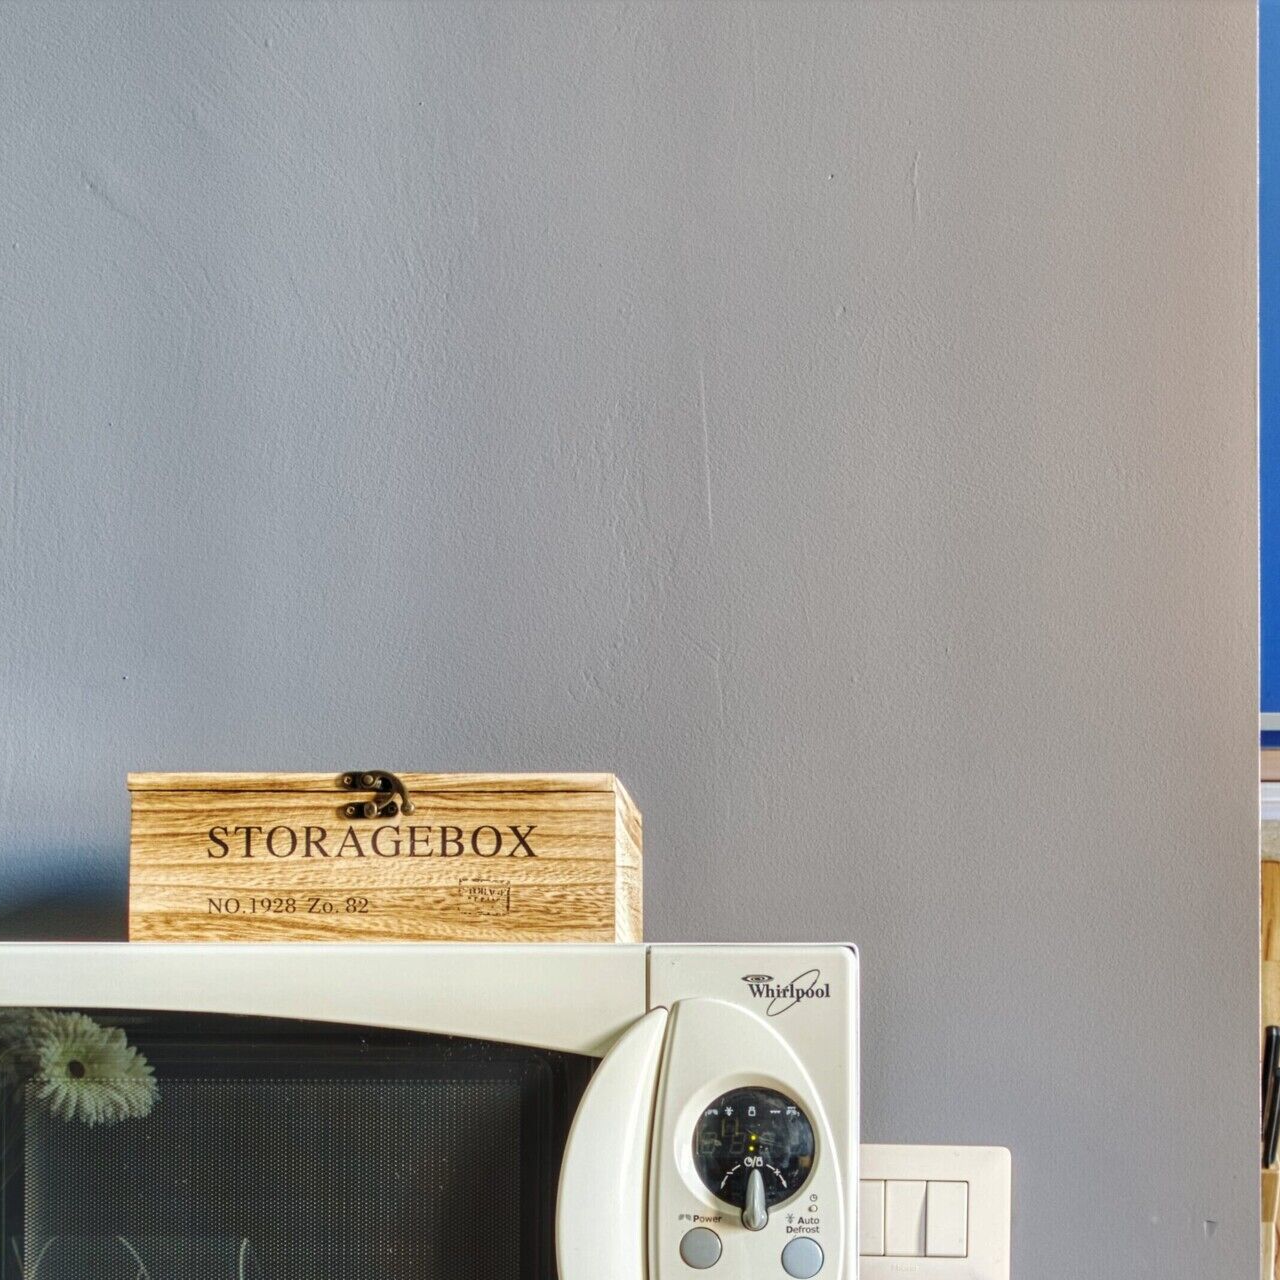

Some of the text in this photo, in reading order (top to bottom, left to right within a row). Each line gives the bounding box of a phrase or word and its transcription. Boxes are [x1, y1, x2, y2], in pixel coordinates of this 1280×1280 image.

[207, 824, 539, 859] STORAGEBOX
[208, 898, 369, 914] NO.1928 Zo. 82
[749, 983, 831, 1002] Whirlpool
[693, 1214, 722, 1223] Power
[797, 1216, 820, 1224] Auto
[786, 1225, 820, 1234] Defrost
